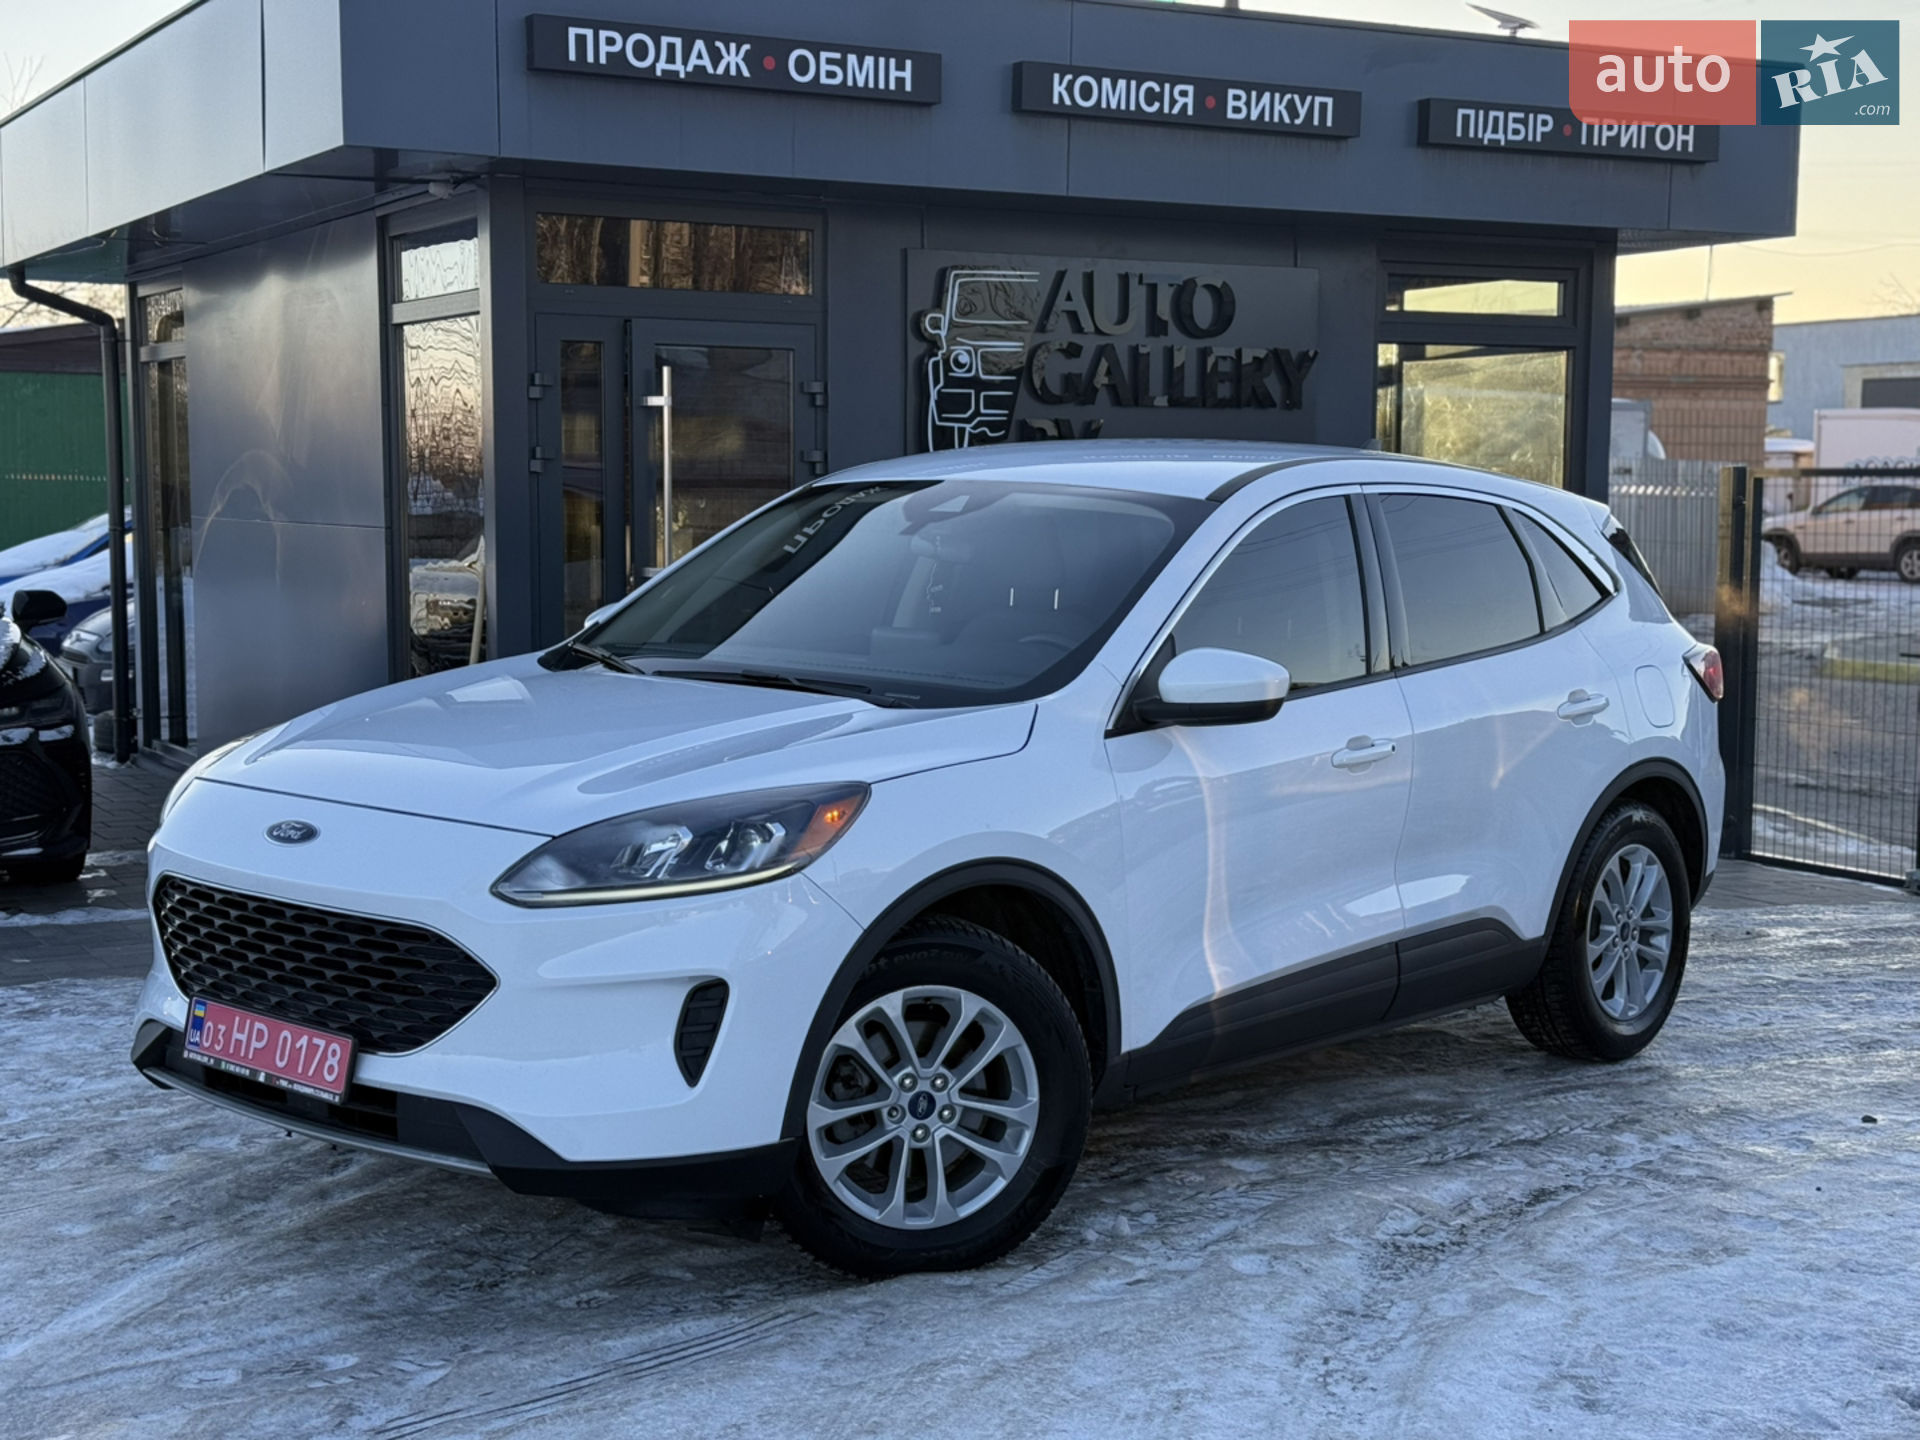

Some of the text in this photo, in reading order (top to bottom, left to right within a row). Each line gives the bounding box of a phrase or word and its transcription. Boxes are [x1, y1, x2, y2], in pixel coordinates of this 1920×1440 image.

[567, 26, 913, 93] ПРОДАЖ ОБМІН
[1051, 72, 1335, 128] КОМІСІЯ ВИКУП
[1455, 108, 1695, 153] ПІДБІР ПРИГОН
[1035, 268, 1237, 340] AUTO
[1025, 339, 1320, 411] GALLERY
[274, 1029, 342, 1083] 0178
